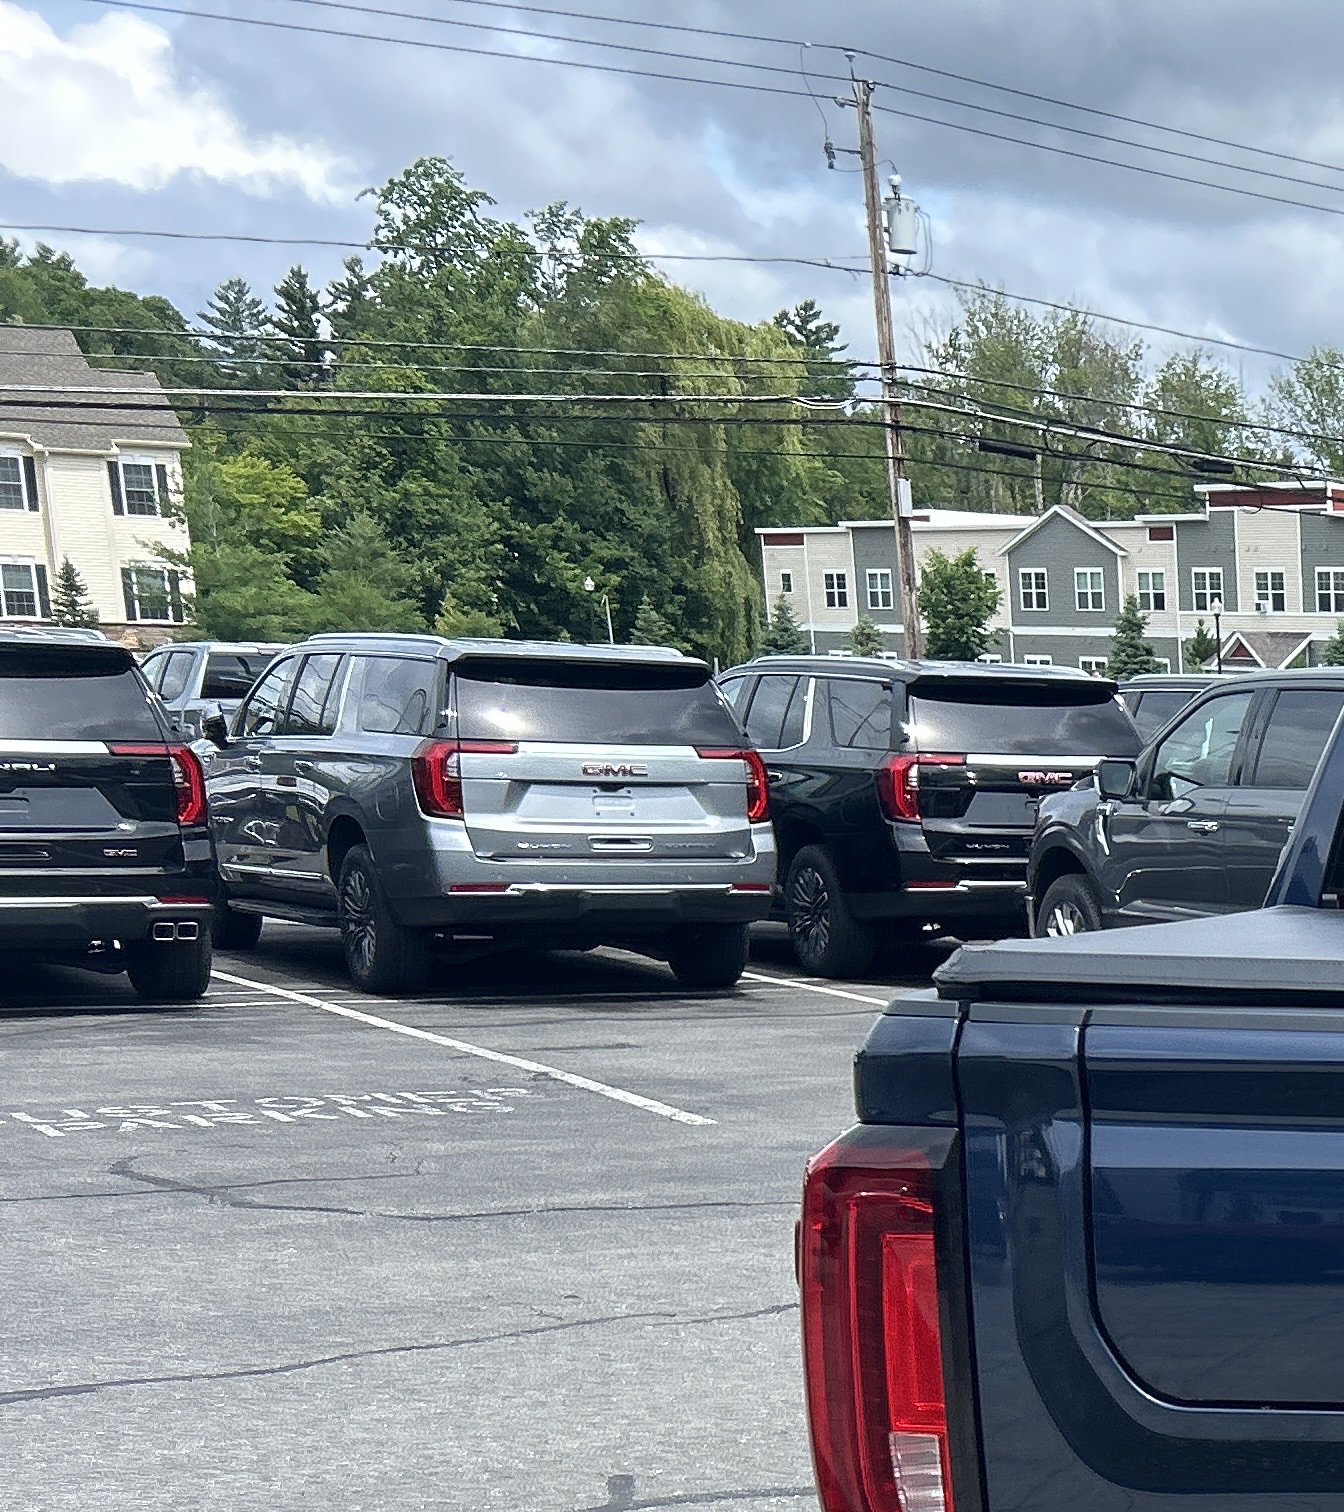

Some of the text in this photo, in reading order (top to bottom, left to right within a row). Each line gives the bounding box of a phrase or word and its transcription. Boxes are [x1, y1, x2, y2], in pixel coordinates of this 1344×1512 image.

[581, 762, 649, 777] GMC
[1018, 771, 1073, 784] GMC
[0, 1087, 542, 1125] USTOMER
[31, 1101, 516, 1137] PARKING
